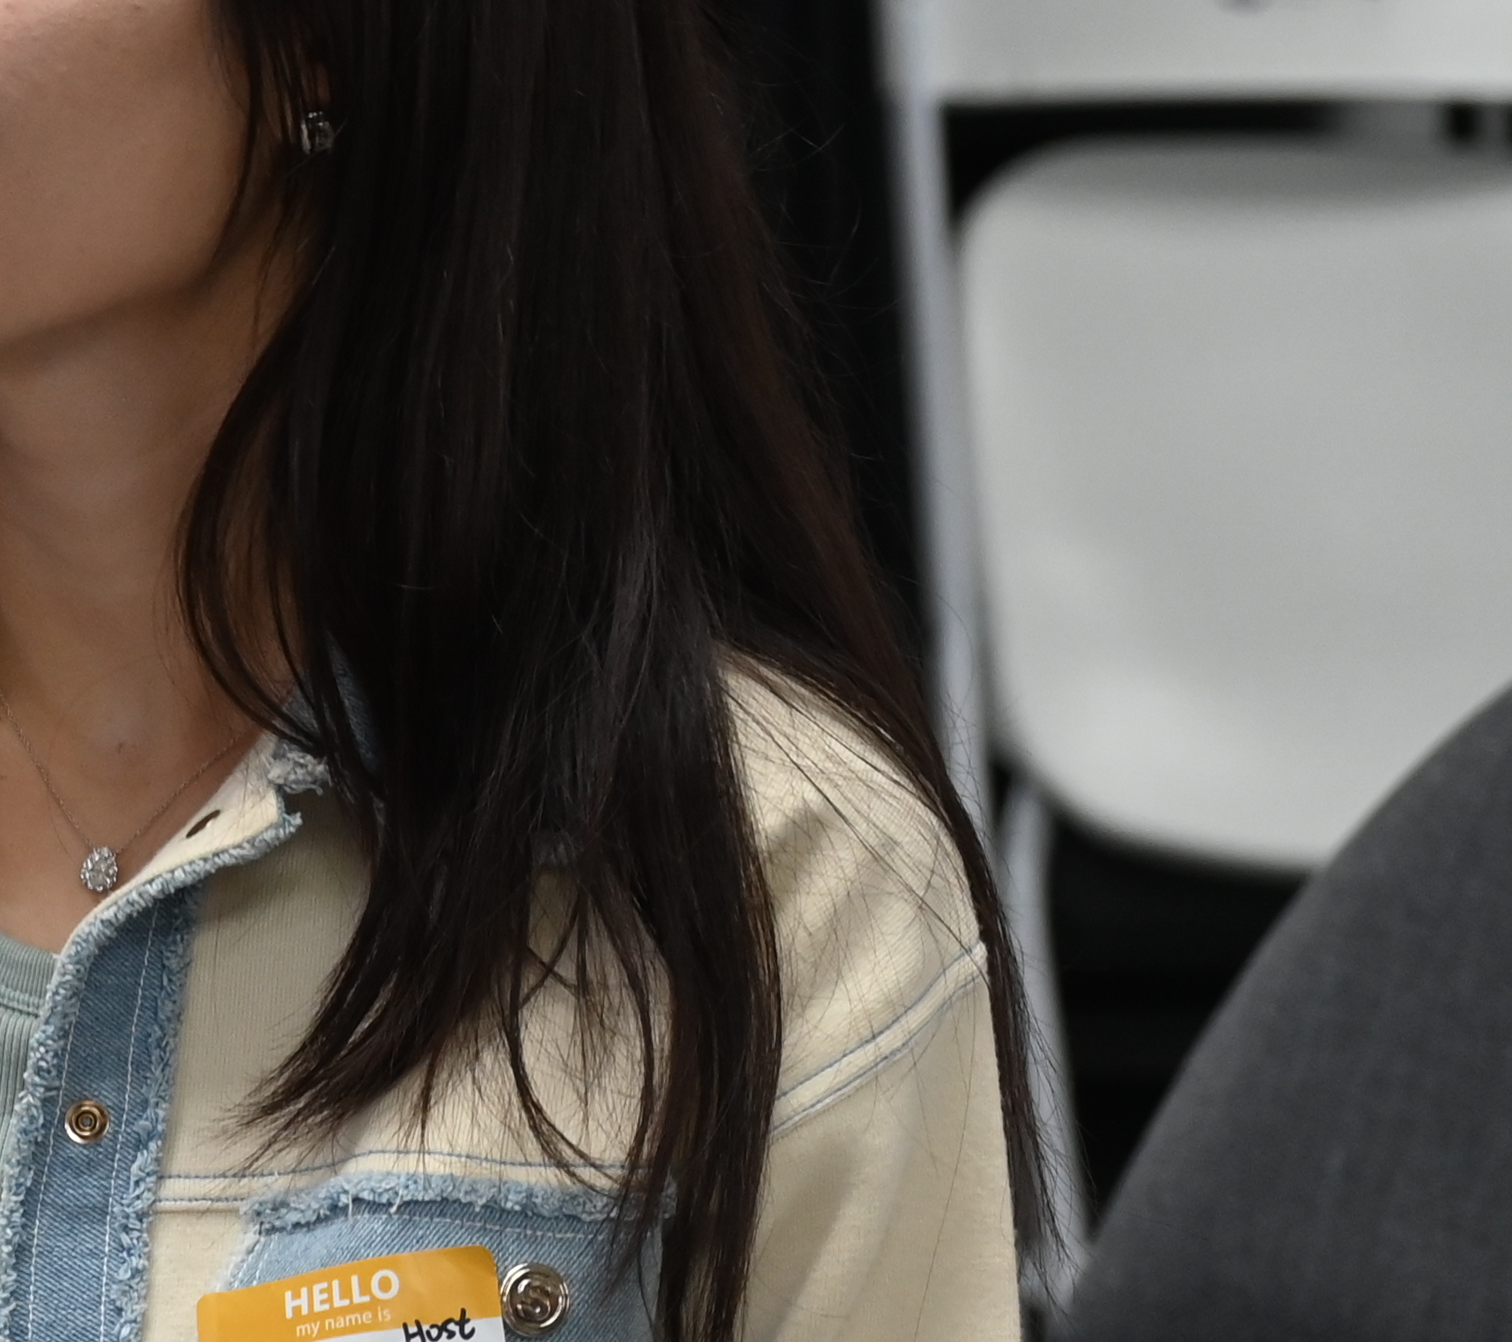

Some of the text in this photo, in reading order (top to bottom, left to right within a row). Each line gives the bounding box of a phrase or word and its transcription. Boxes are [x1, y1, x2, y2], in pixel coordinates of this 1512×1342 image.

[284, 1268, 401, 1319] HELLO
[296, 1307, 391, 1338] my name is
